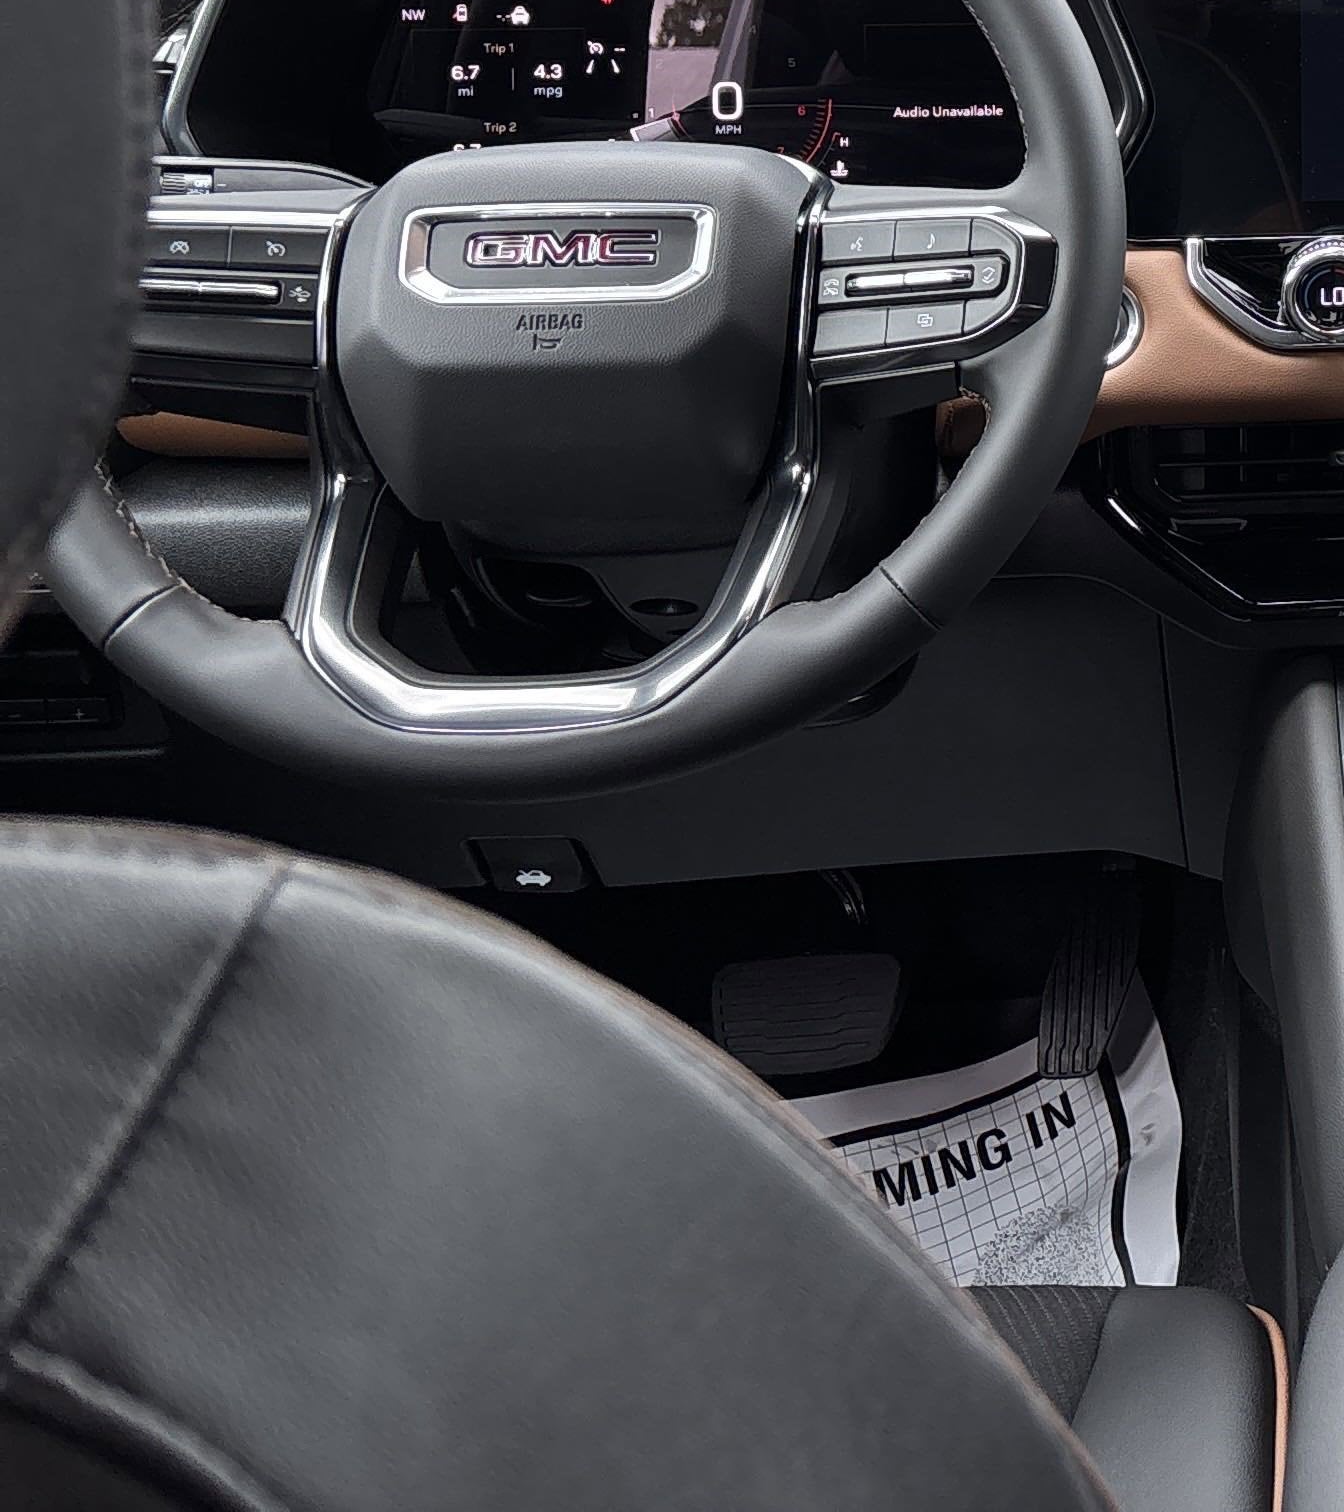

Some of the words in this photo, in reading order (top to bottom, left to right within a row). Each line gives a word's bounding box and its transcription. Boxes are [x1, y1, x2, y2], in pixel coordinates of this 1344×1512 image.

[401, 9, 426, 21] NW
[483, 43, 507, 56] Trip
[508, 43, 515, 54] 1
[787, 58, 796, 68] 5
[450, 64, 481, 81] 6.7
[533, 64, 564, 80] 4.3
[457, 85, 474, 97] mi
[533, 86, 563, 99] mpg
[712, 81, 743, 120] 0
[797, 105, 806, 116] 6
[893, 105, 930, 118] Audio
[932, 104, 1004, 118] Unavailable
[483, 122, 507, 135] Trip
[508, 122, 518, 133] 2
[715, 124, 742, 135] MPH
[839, 137, 849, 148] H
[464, 230, 661, 268] GMC
[515, 313, 584, 331] AIRBAG
[871, 1126, 1015, 1208] MING
[1026, 1090, 1078, 1150] IN
